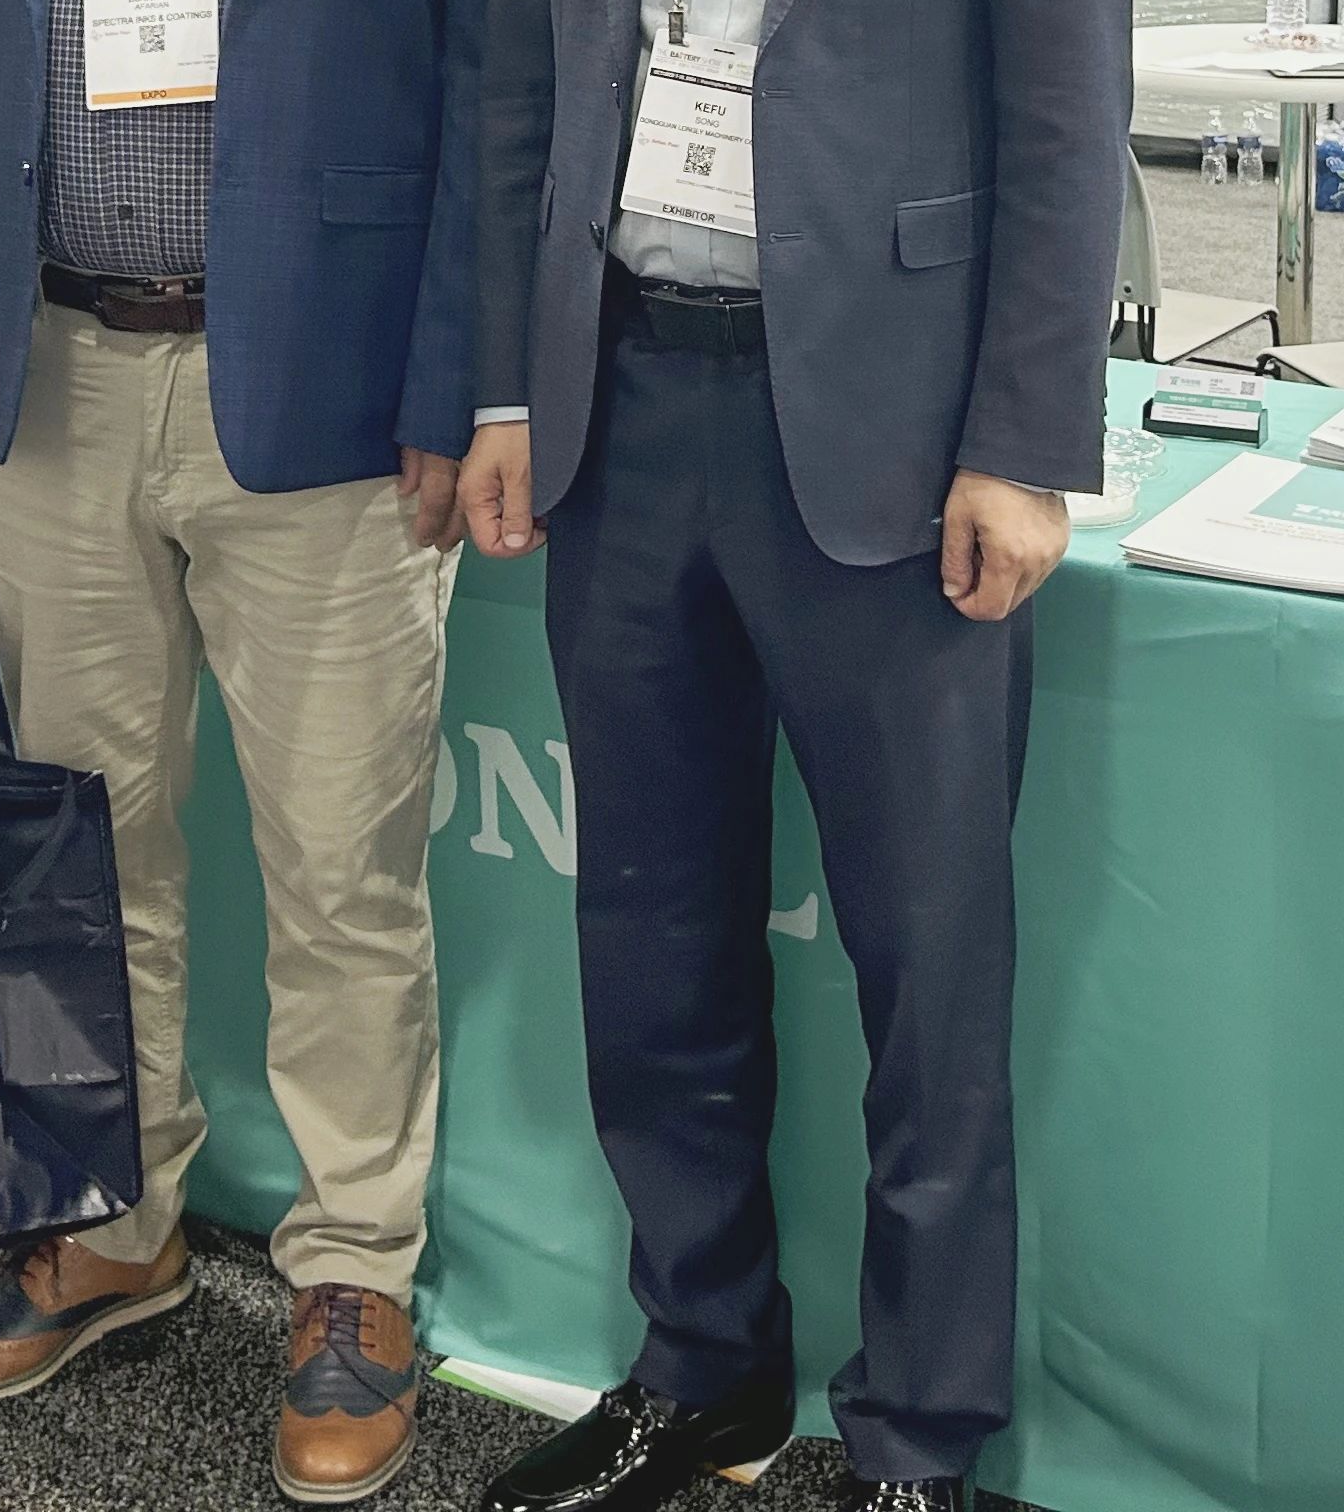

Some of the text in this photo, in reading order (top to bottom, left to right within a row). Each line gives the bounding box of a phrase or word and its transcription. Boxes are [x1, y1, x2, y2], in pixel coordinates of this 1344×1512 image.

[166, 10, 213, 22] COATINGS
[141, 89, 167, 100] EXPO
[694, 100, 727, 117] KEFU
[694, 116, 720, 128] SONG
[662, 202, 716, 224] EXHIBITOR
